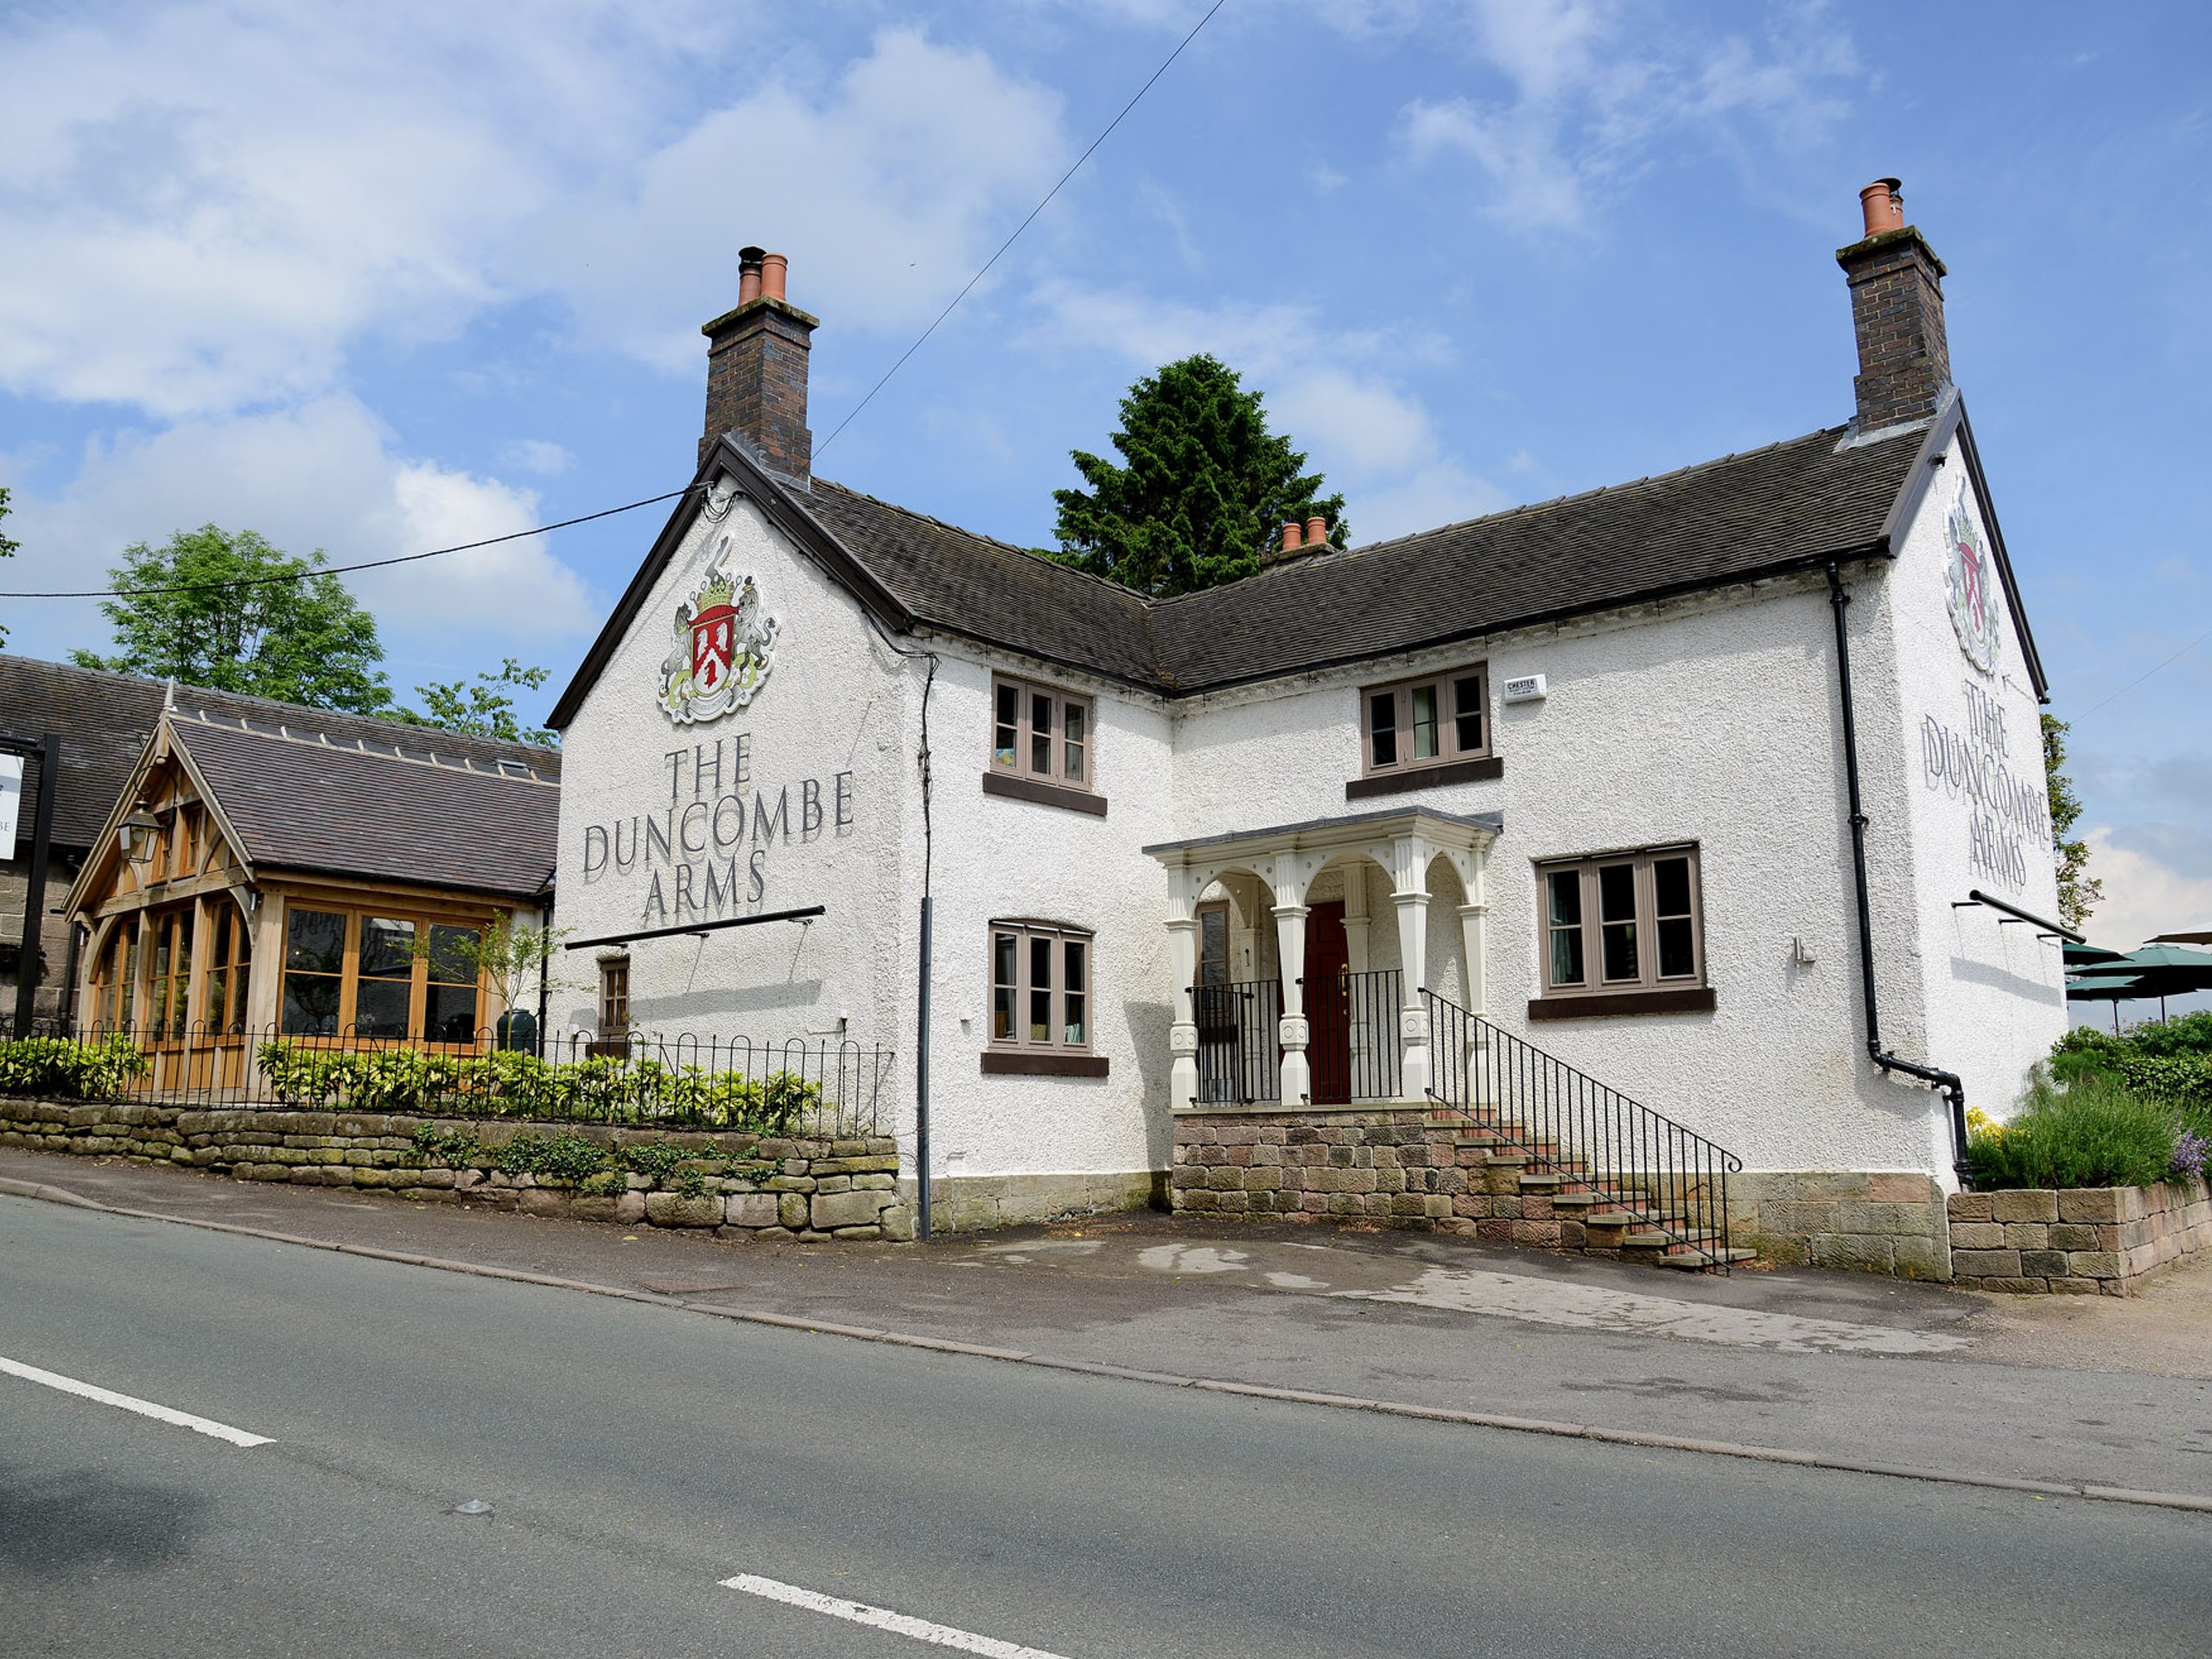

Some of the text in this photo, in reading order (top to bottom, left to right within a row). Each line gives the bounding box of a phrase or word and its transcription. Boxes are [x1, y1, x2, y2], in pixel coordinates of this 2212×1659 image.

[1507, 679, 1535, 690] CHESTER
[1964, 678, 2009, 759] THE
[664, 732, 752, 800] THE
[1924, 713, 2050, 842] DUNCOMBE
[583, 770, 855, 874] DUNCOMBE
[1973, 804, 2027, 887] ARMS
[642, 849, 767, 919] ARMS
